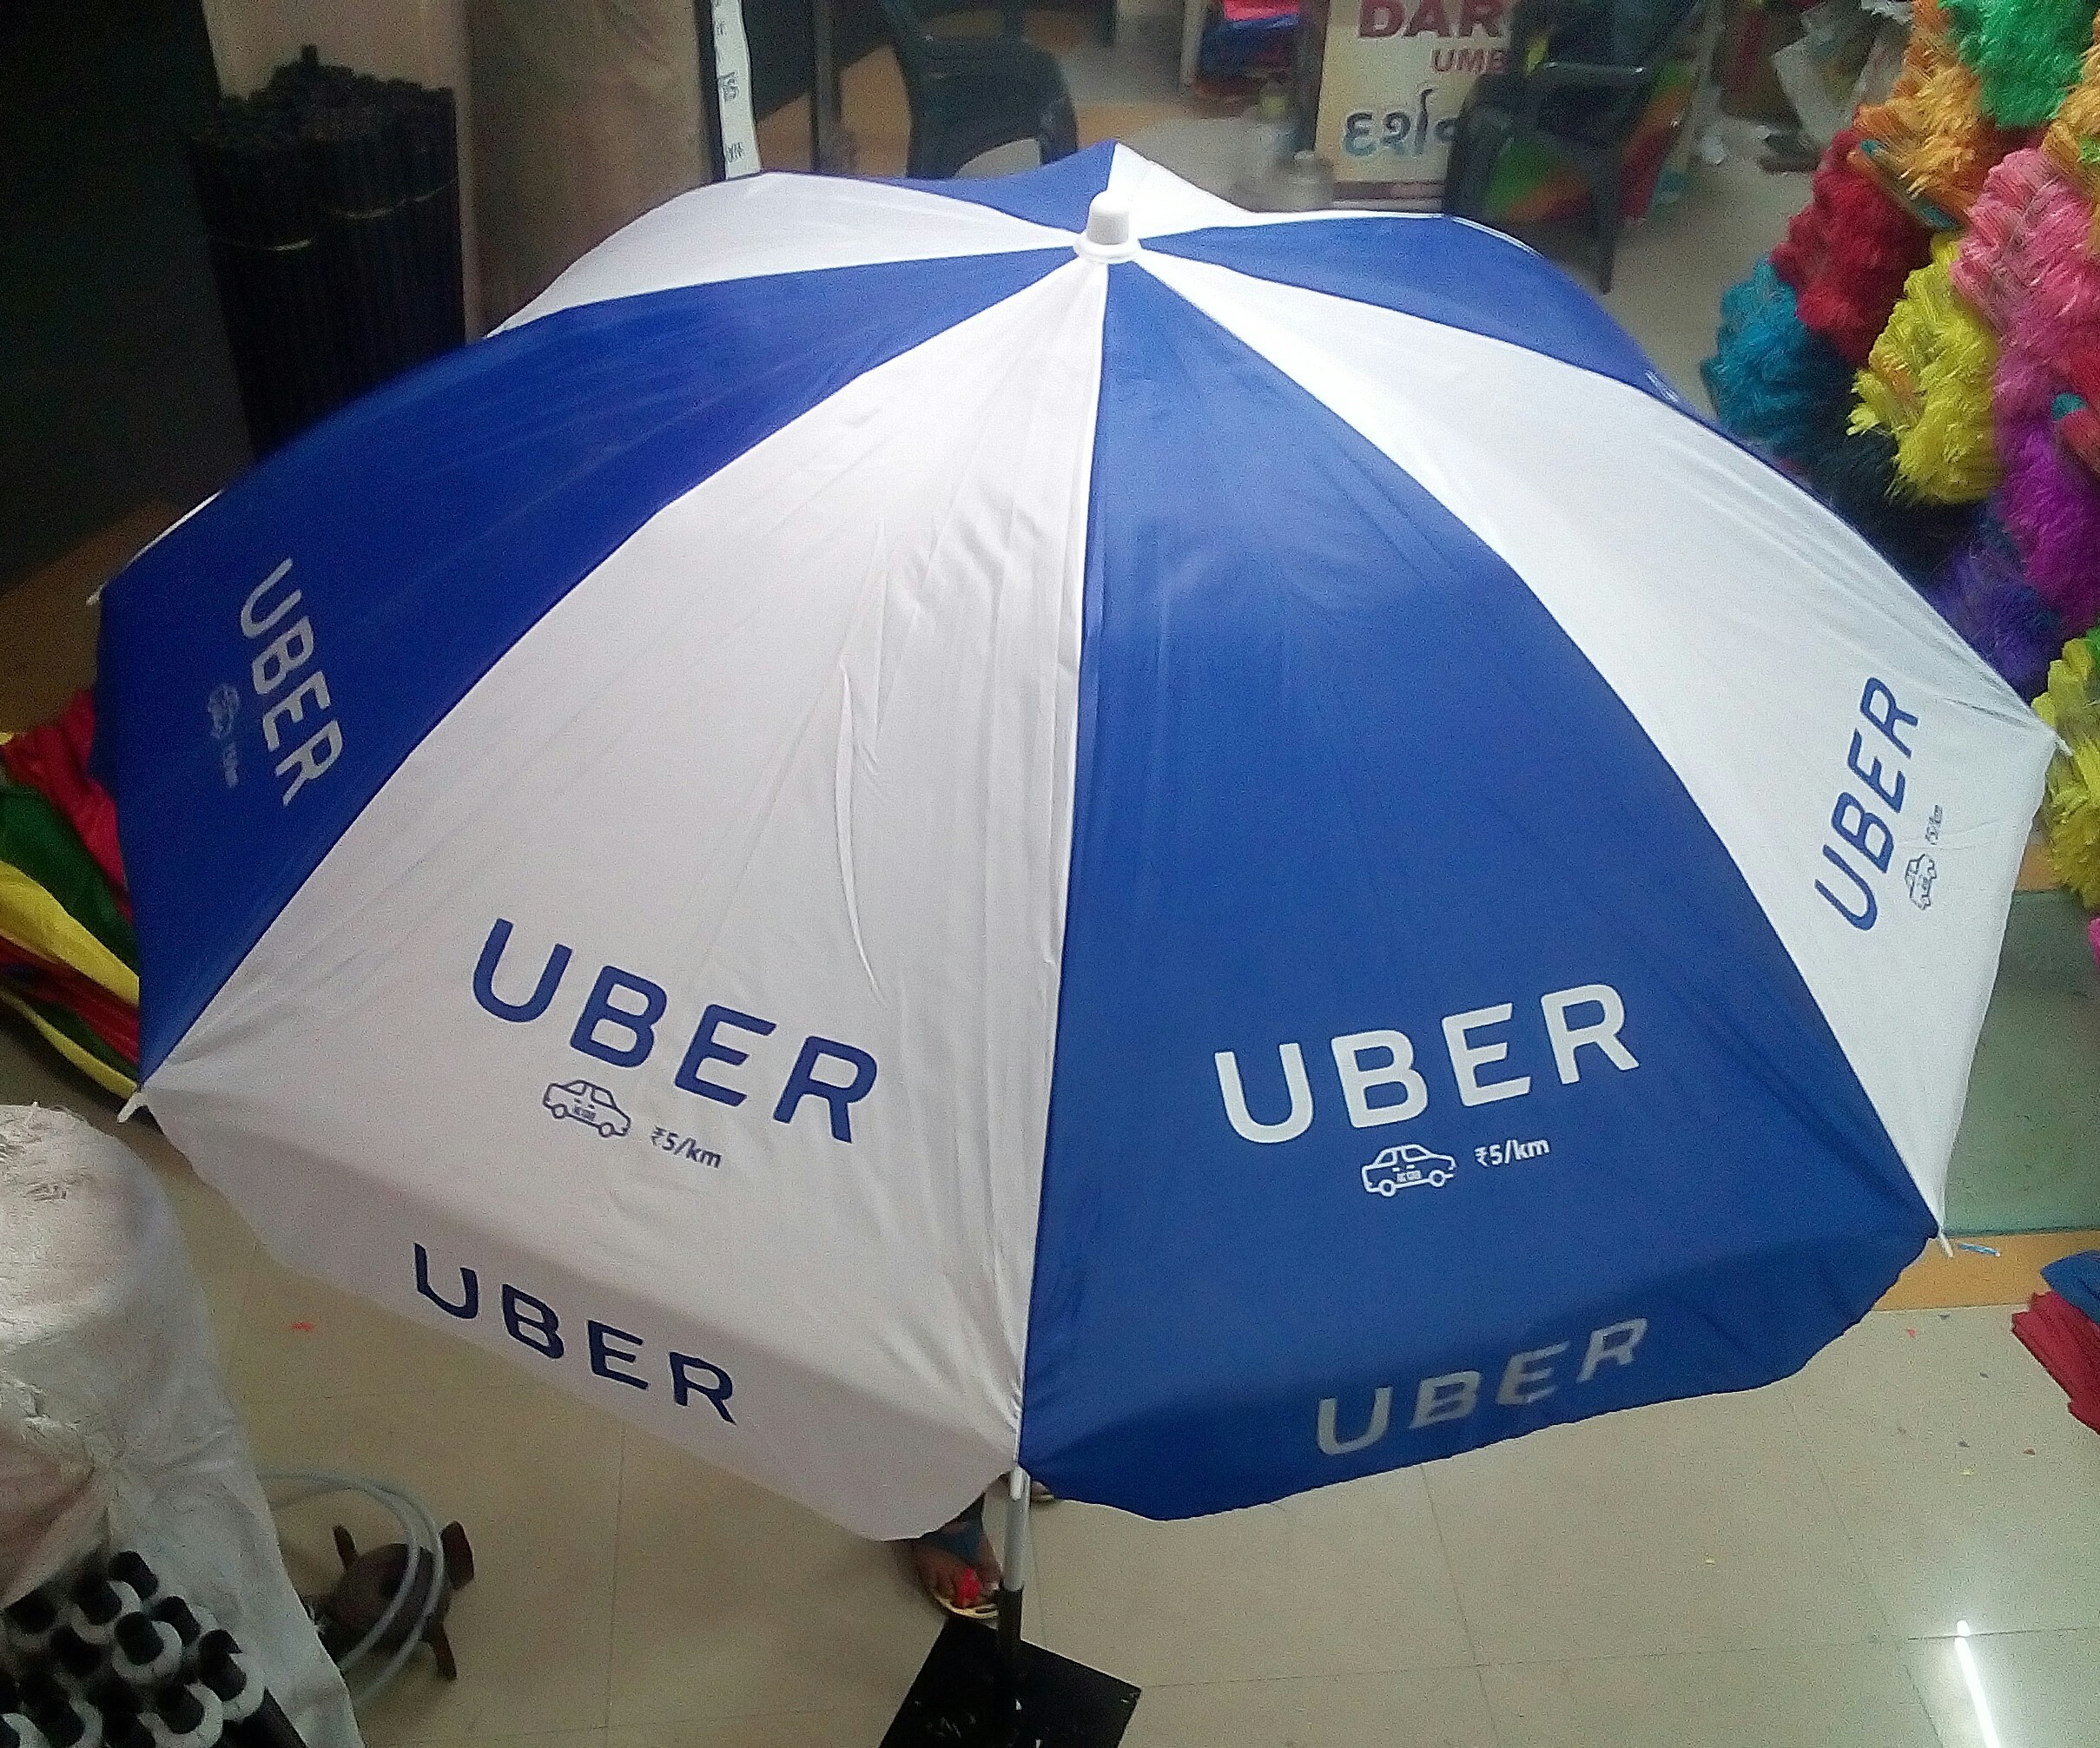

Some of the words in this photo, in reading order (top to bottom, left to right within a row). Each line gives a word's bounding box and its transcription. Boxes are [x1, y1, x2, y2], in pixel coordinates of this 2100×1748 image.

[241, 557, 344, 807] UBER
[1814, 676, 1918, 931] UBER
[472, 918, 878, 1144] UBER
[1214, 984, 1640, 1144] UBER
[1474, 1139, 1550, 1167] ₹5/km
[413, 1243, 736, 1425] UBER
[1317, 1317, 1648, 1456] UBER
